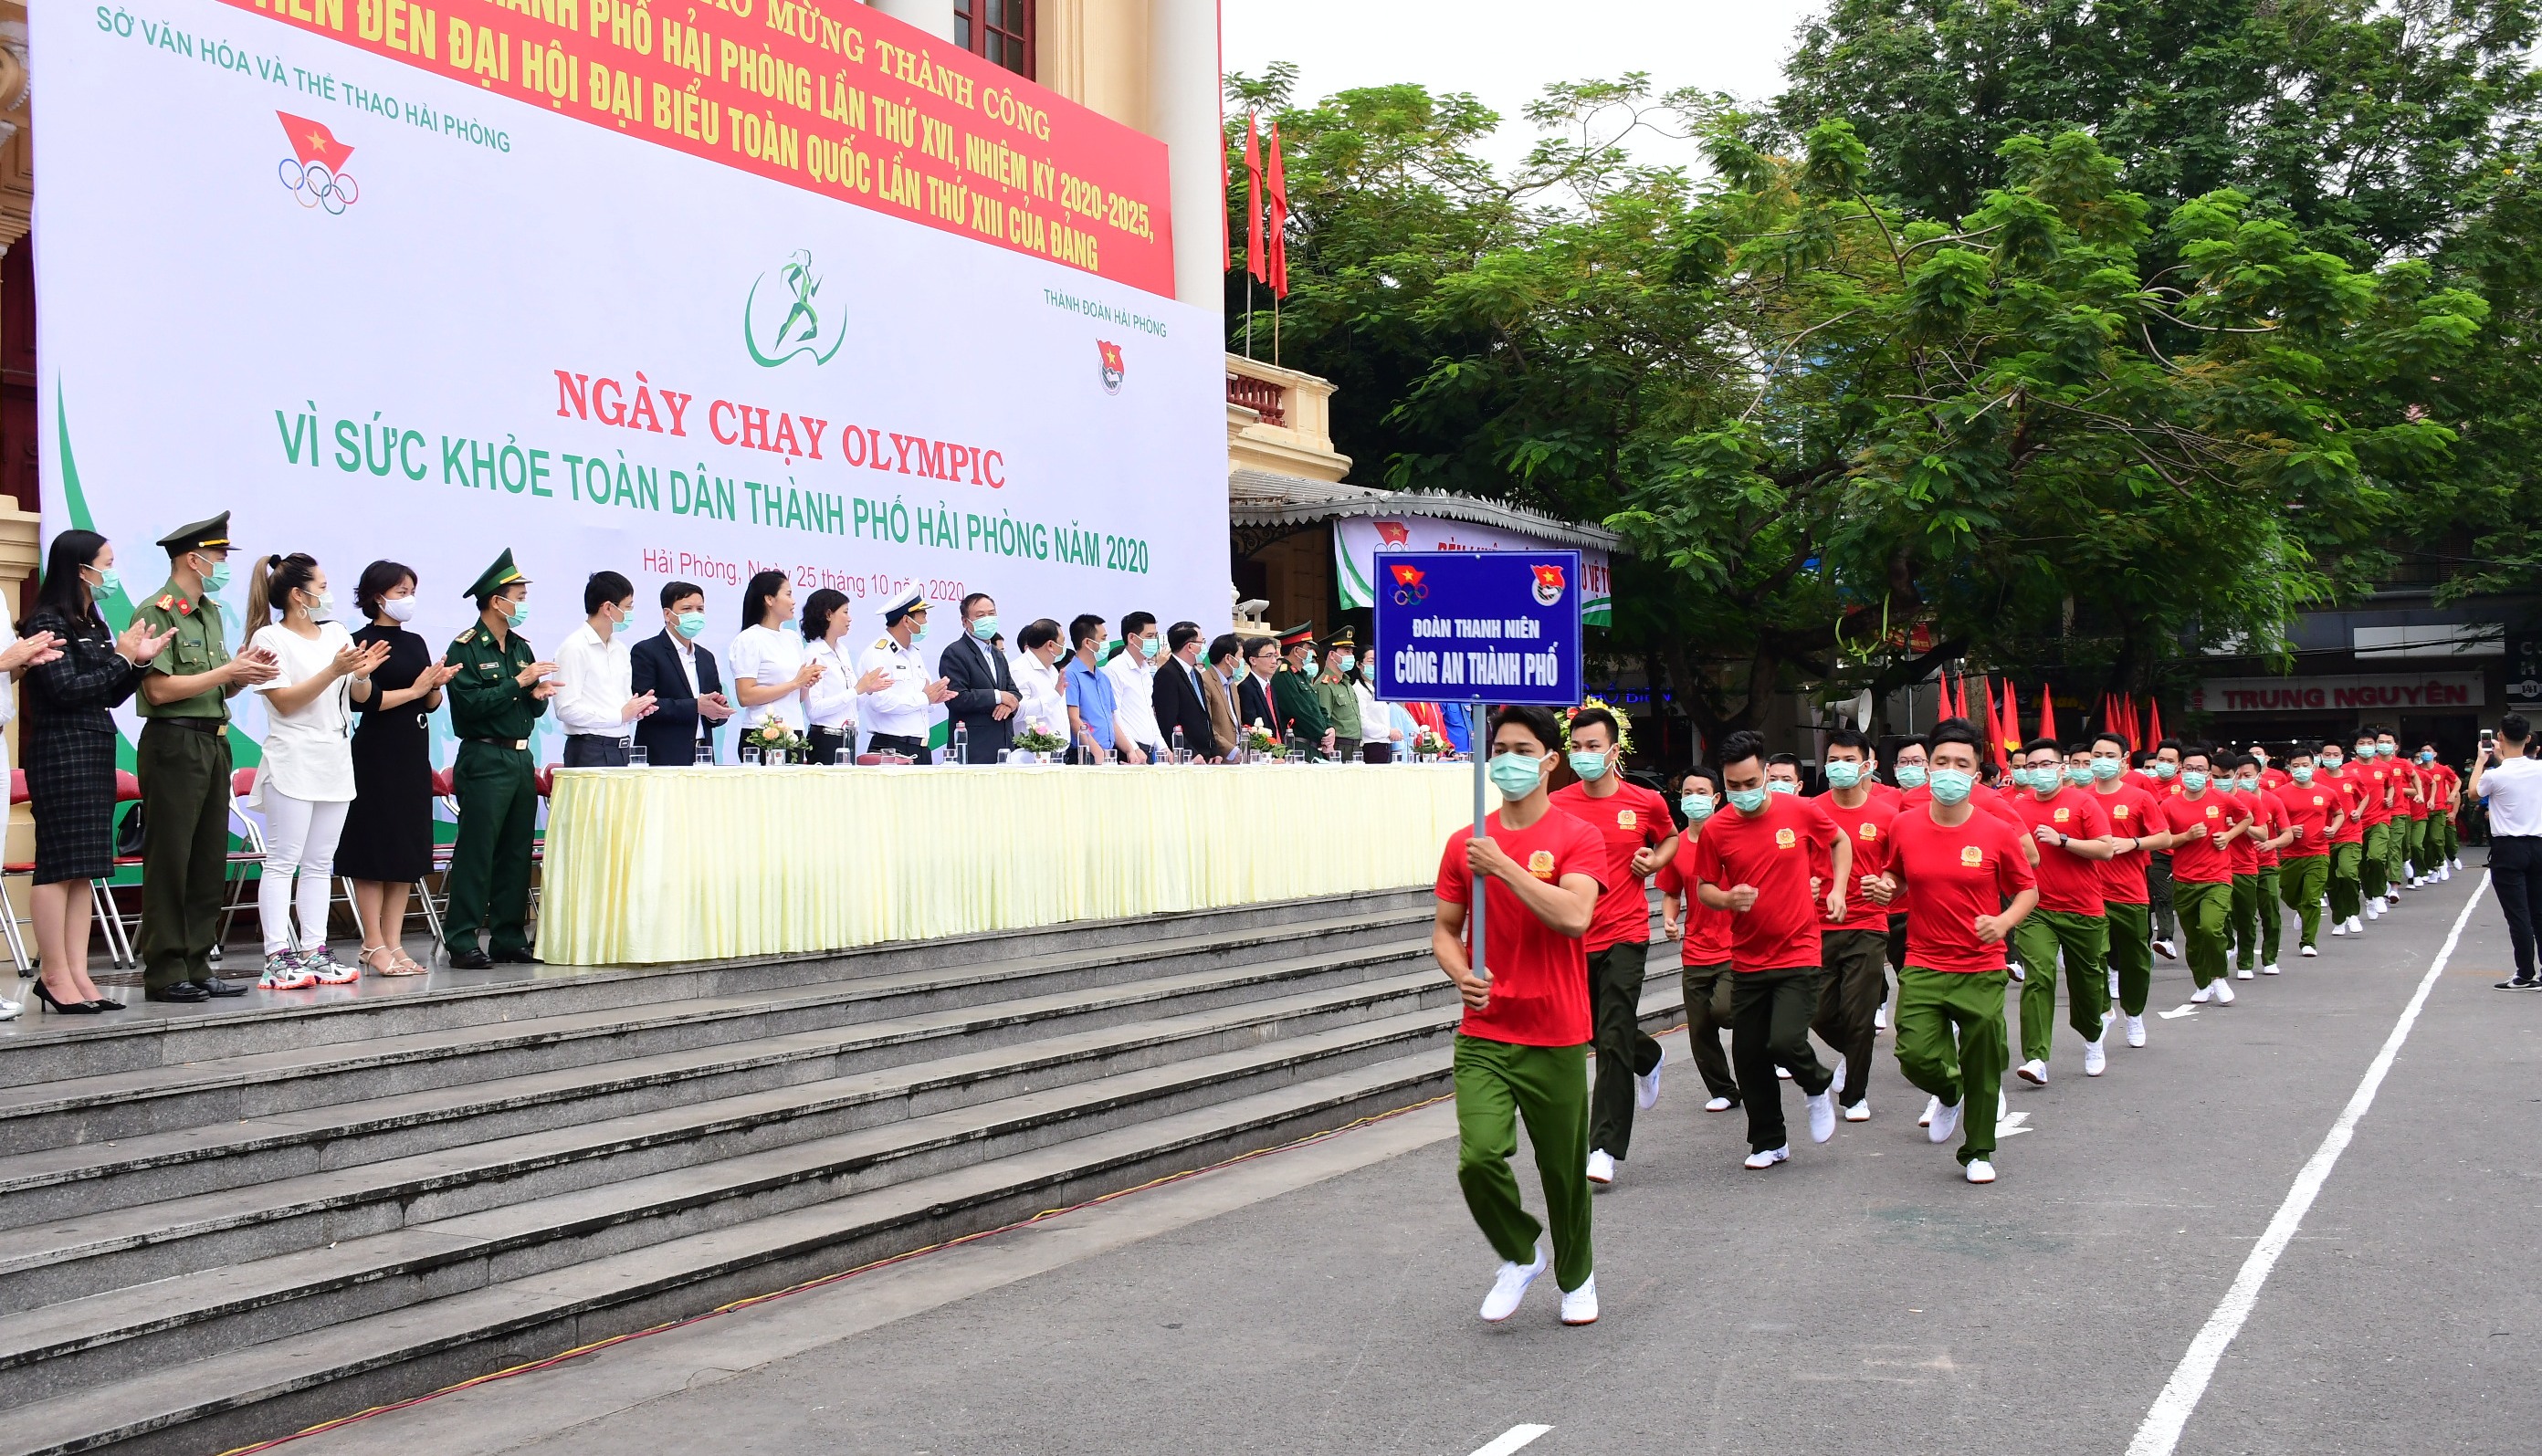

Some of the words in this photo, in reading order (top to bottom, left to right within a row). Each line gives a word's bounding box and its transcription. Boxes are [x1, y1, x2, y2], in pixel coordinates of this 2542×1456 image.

[97, 5, 134, 38] SỞ
[142, 19, 193, 58] VĂN
[200, 39, 251, 77] HÓA
[257, 55, 289, 87] VÀ
[293, 67, 336, 101] THỂ
[341, 82, 399, 120] THAO
[405, 100, 437, 131] HẢI
[444, 114, 510, 153] PHÒNG
[662, 7, 710, 77] HẢI
[720, 38, 812, 110] PHÒNG
[820, 68, 865, 132] LẦN
[873, 96, 918, 149] THỨ
[920, 114, 961, 169] XVI,
[965, 133, 1026, 194] NHIỆM
[1033, 157, 1056, 202] KỲ
[1061, 172, 1154, 244] 2020-2025,
[874, 40, 974, 108] THÀNH
[982, 87, 1051, 141] CÔNG
[448, 16, 509, 88] ĐẠI
[521, 39, 578, 109] HỘI
[589, 62, 642, 128] ĐẠI
[653, 77, 720, 145] BIỂU
[728, 107, 799, 171] TOÀN
[806, 133, 871, 194] QUỐC
[877, 149, 920, 211] LẦN
[926, 173, 967, 225] THỨ
[972, 191, 1003, 239] XIII
[1008, 196, 1046, 253] CỦA
[1049, 211, 1098, 272] ĐẢNG
[1044, 289, 1081, 313] THÀNH
[1083, 299, 1111, 322] ĐOÀN
[1113, 304, 1131, 328] HẢI
[1133, 312, 1167, 339] PHÒNG
[553, 370, 691, 437] NGÀY
[709, 399, 828, 467] CHẠY
[842, 424, 1005, 489] OLYMPIC
[275, 399, 320, 467] VÌ
[334, 411, 428, 481] SỨC
[441, 433, 553, 498] KHỎE
[562, 449, 660, 512] TOÀN
[670, 462, 736, 521] DÂN
[744, 476, 845, 536] THÀNH
[853, 493, 909, 545] PHỐ
[918, 500, 960, 550] HẢI
[966, 508, 1048, 561] PHÒNG
[1054, 519, 1100, 568] NĂM
[1106, 534, 1149, 574] 2020
[643, 548, 674, 574] Hải
[679, 551, 742, 586] Phòng,
[796, 565, 817, 589] 25
[821, 569, 866, 599] tháng
[871, 574, 889, 595] 10
[930, 581, 965, 602] 2020
[1394, 644, 1437, 686] CÔNG
[1441, 651, 1465, 686] AN
[1468, 645, 1521, 686] THÀNH
[1524, 641, 1560, 687] PHỐ
[1412, 614, 1452, 638] ĐOÀN
[1455, 619, 1502, 639] THANH
[1504, 615, 1540, 639] NIÊN
[2223, 687, 2325, 709] TRUNG
[2334, 680, 2469, 707] NGUYÊN
